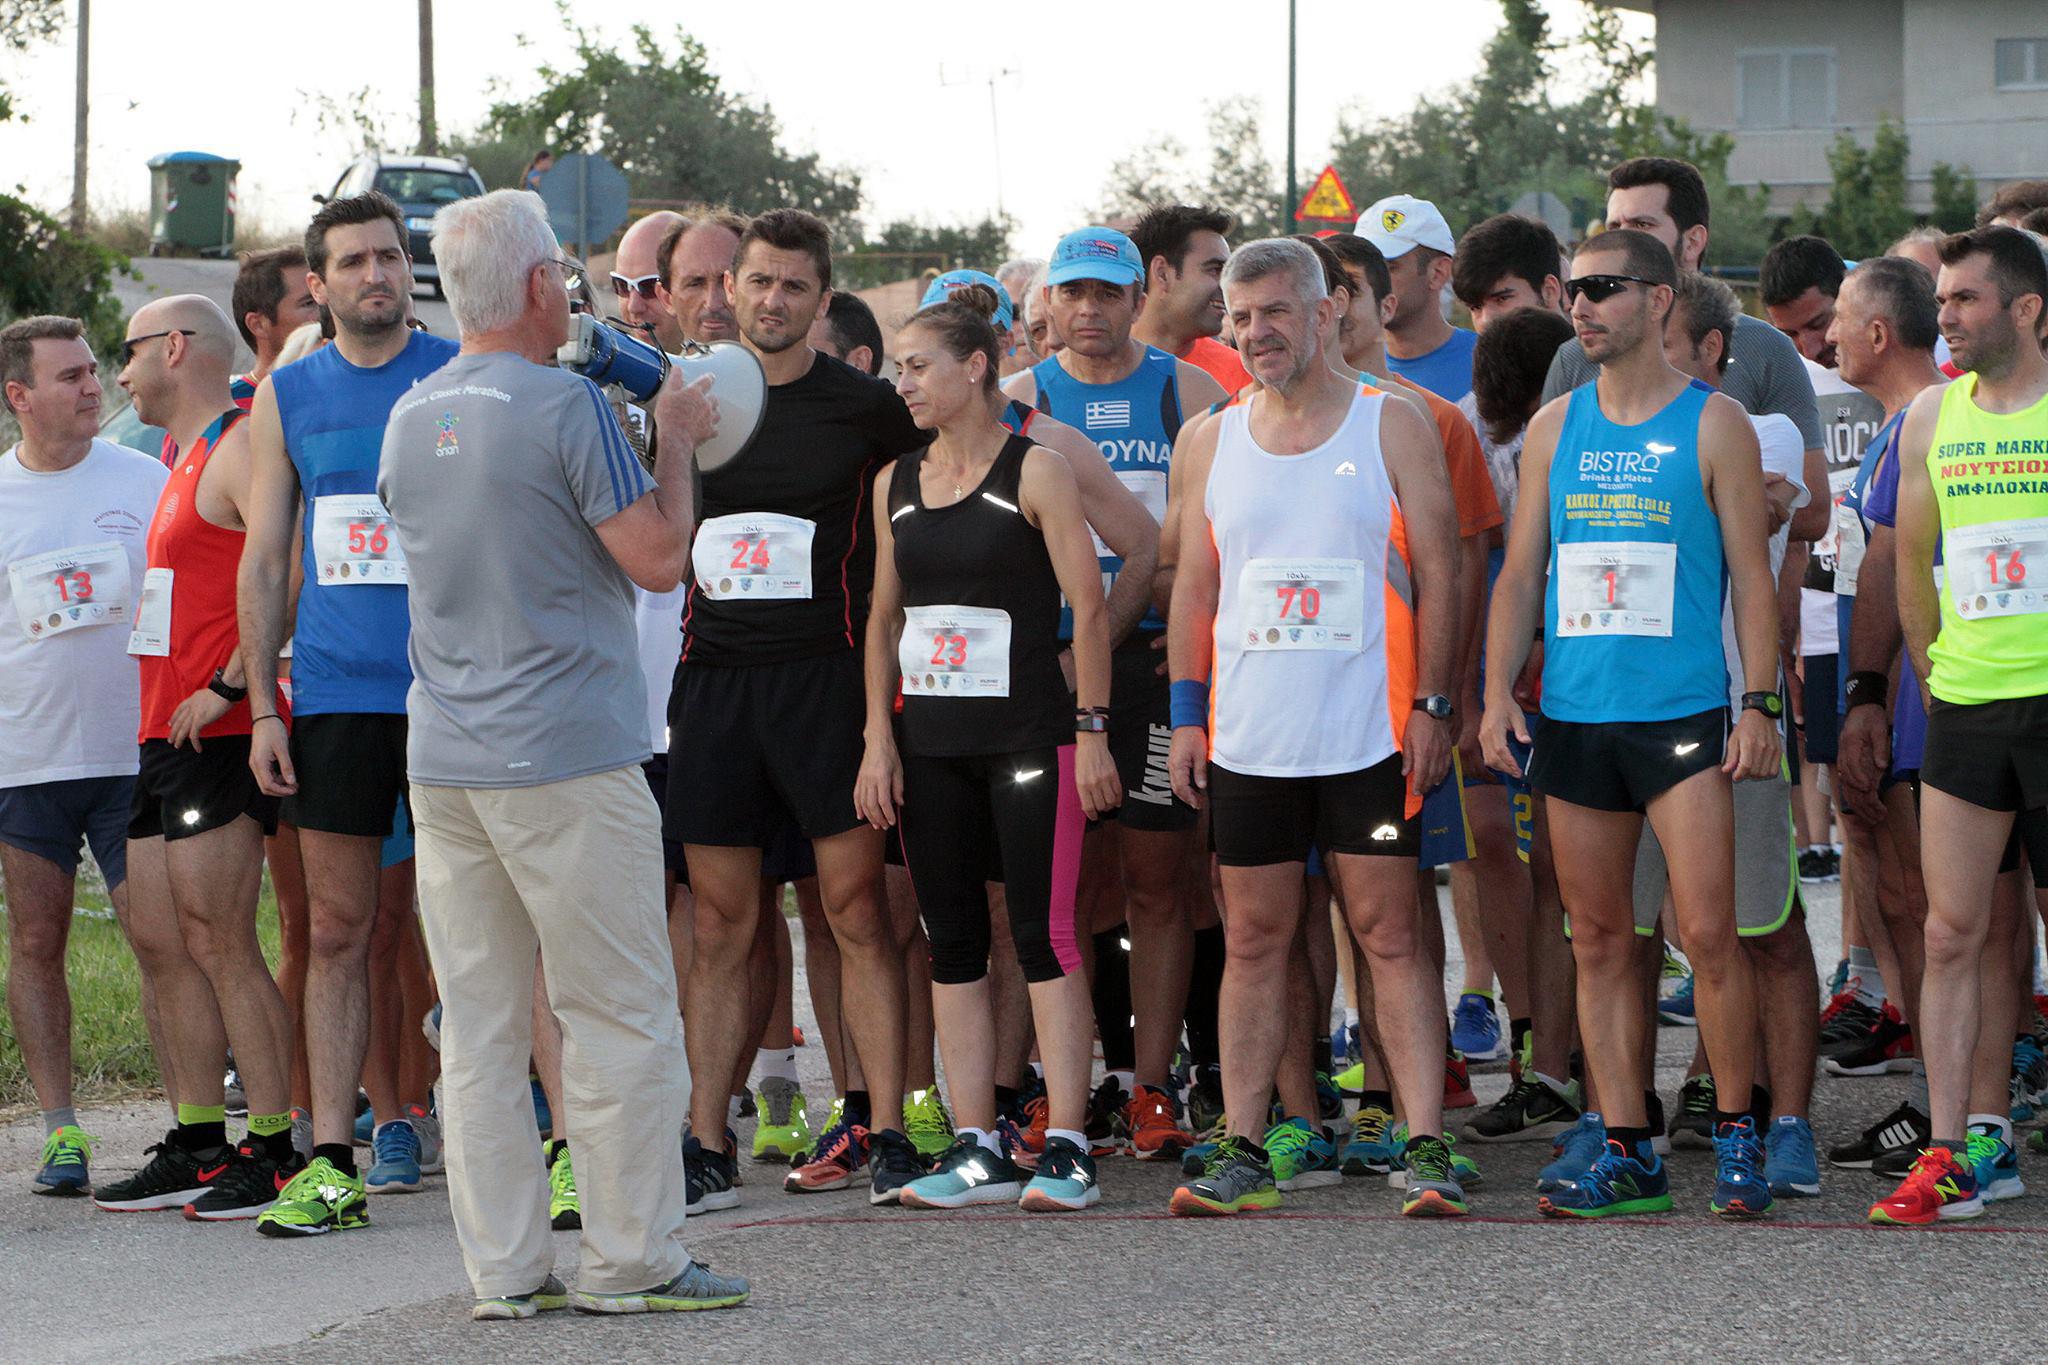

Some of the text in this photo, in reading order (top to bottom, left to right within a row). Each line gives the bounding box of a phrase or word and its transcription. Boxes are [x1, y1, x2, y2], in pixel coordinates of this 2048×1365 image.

[463, 384, 511, 403] Marathon
[1938, 441, 1986, 459] SUPER
[1580, 473, 1653, 484] Drinks & Plates
[348, 523, 389, 554] 56
[730, 539, 770, 569] 24
[1985, 550, 2026, 584] 16
[54, 571, 94, 602] 13
[1602, 570, 1618, 603] 1
[1276, 586, 1321, 619] 70
[930, 634, 968, 666] 23
